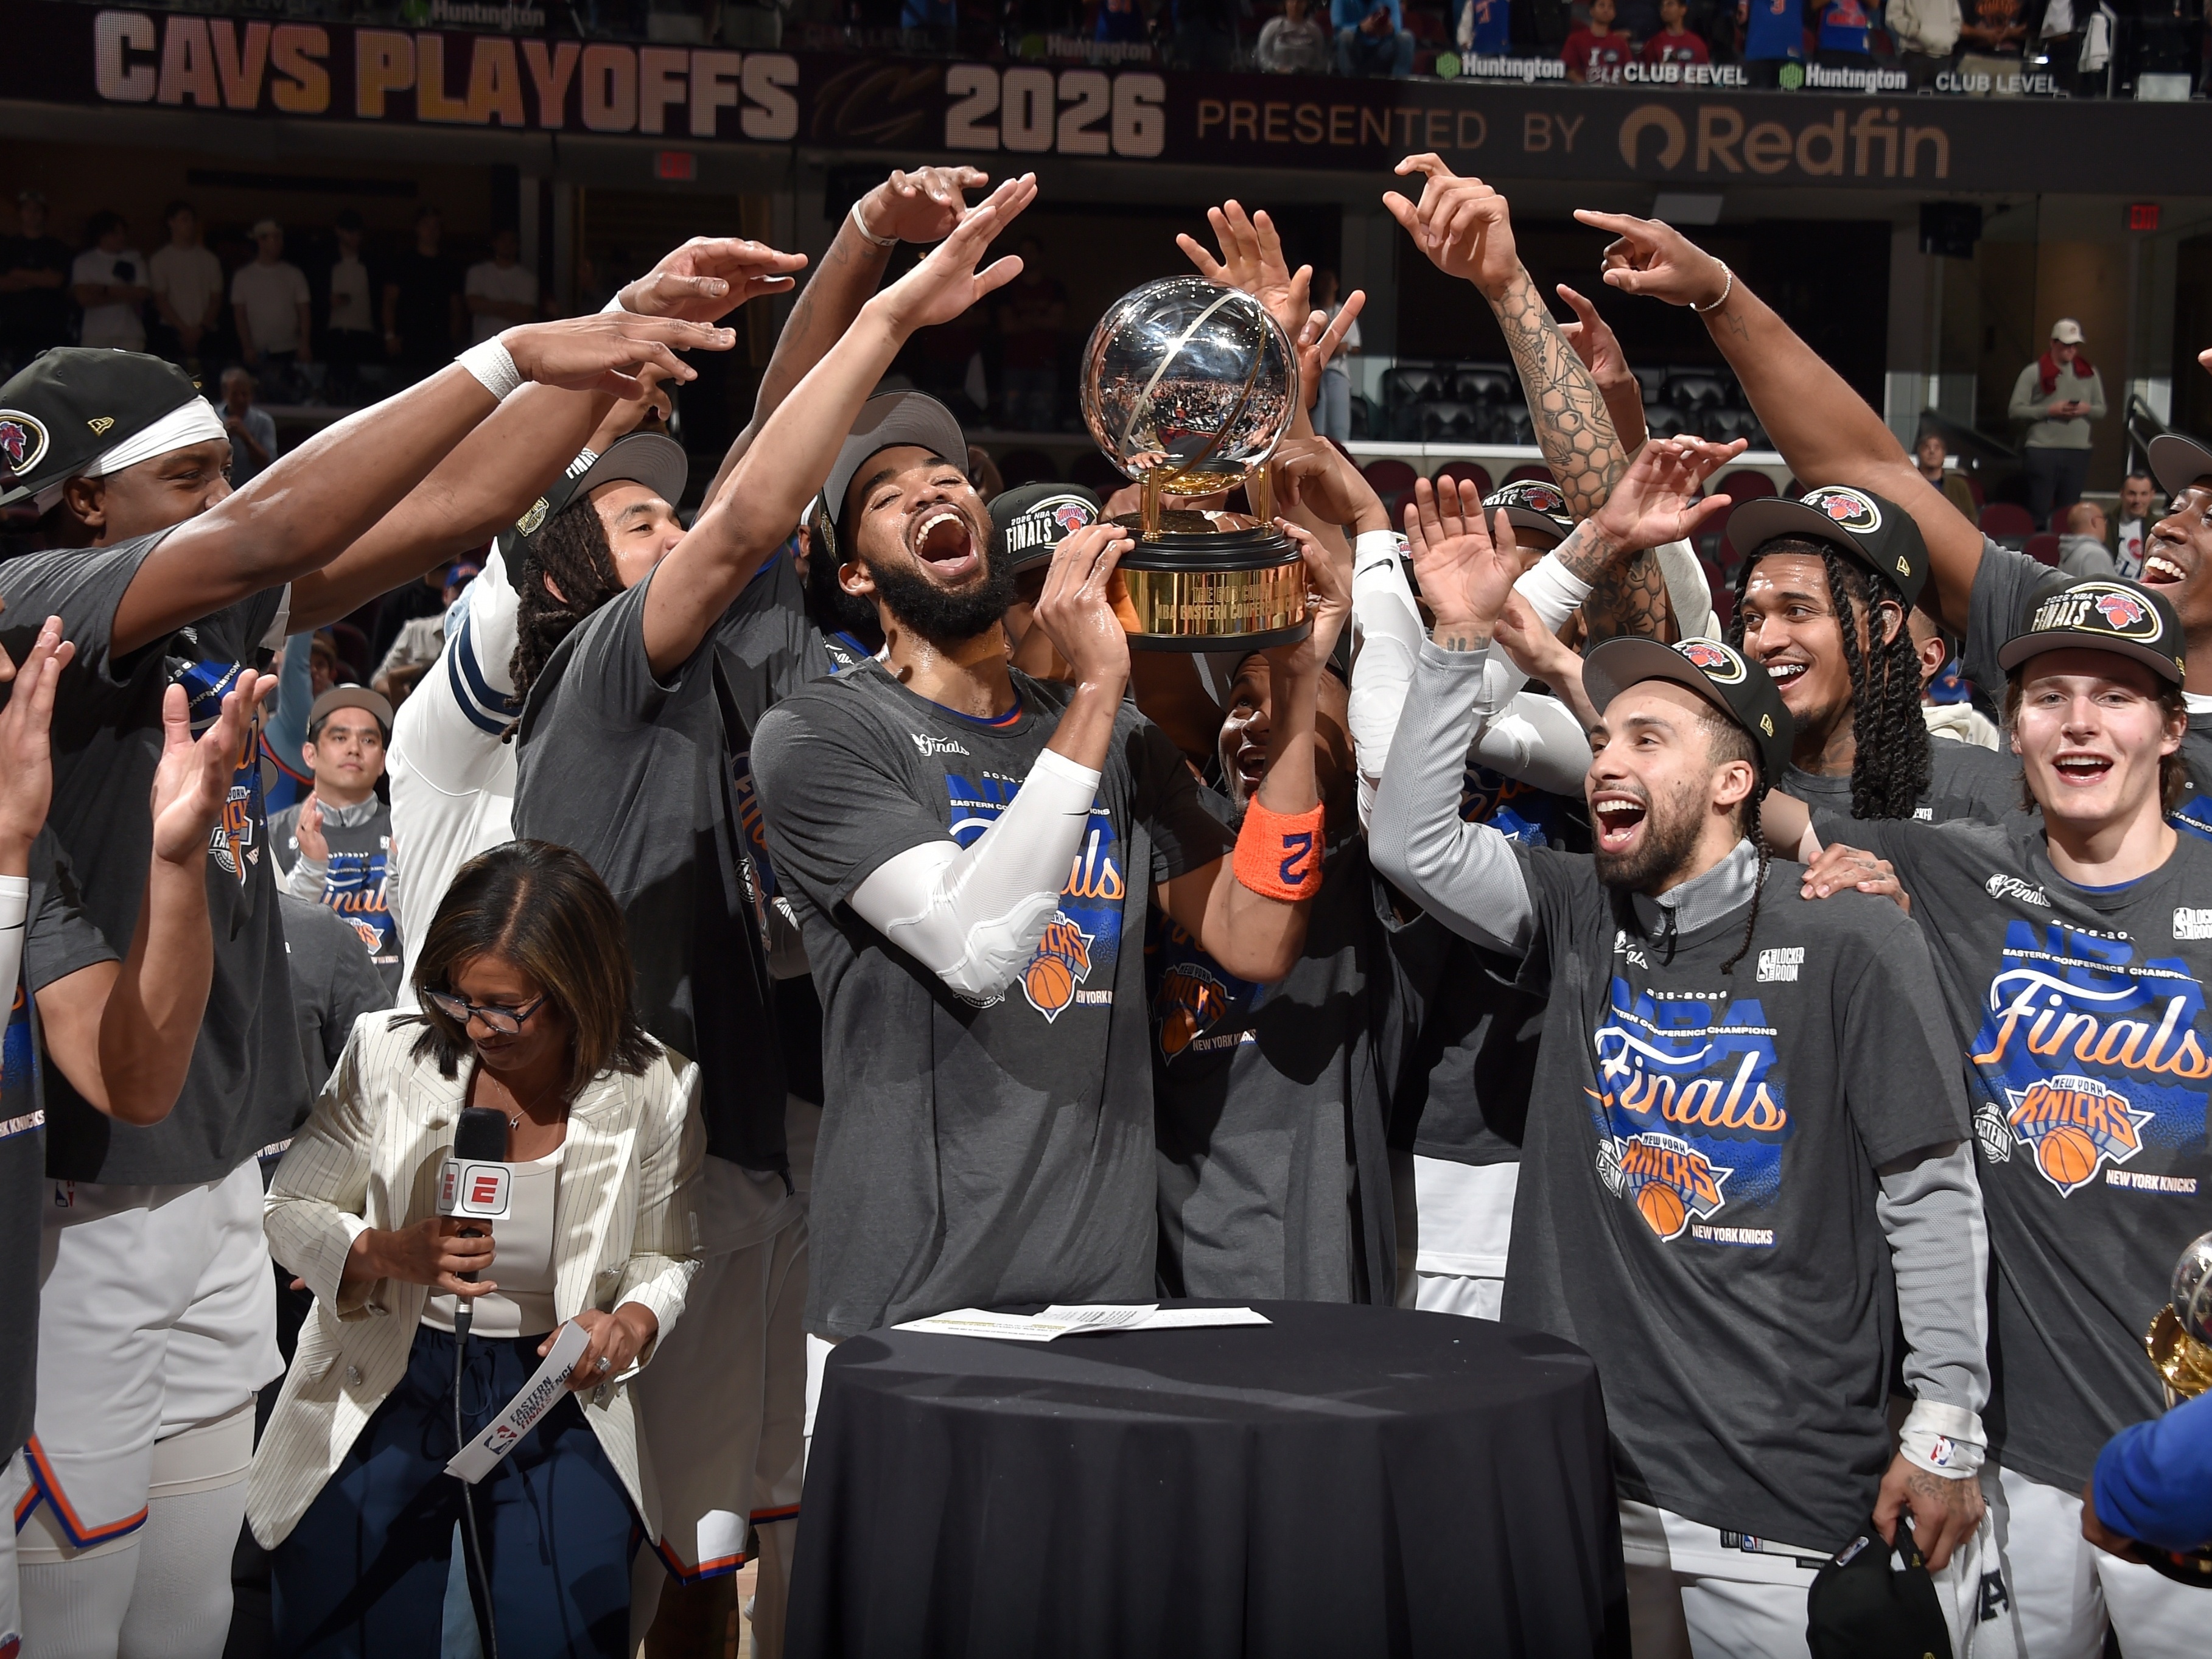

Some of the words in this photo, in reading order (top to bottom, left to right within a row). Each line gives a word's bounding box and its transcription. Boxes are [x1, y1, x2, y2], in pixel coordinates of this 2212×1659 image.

[94, 9, 331, 114] CAVS
[354, 29, 799, 141] PLAYOFFS
[1463, 53, 1566, 83] Huntington
[1623, 61, 1680, 83] CLUB
[1805, 63, 1908, 94] Huntington
[1936, 72, 1992, 92] CLUB
[1995, 74, 2060, 94] LEVEL
[945, 64, 1166, 157] 2026
[1197, 99, 1487, 150] PRESENTED
[1524, 111, 1584, 153] BY
[1696, 107, 1947, 178] Redfin
[1034, 510, 1051, 520] NBA
[1005, 517, 1052, 554] FINALS
[2071, 592, 2094, 601] NBA
[1180, 604, 1227, 620] EASTERN
[1230, 599, 1282, 620] CONFERE
[2030, 600, 2092, 632] FINALS
[982, 770, 1027, 784] 2025-
[950, 799, 995, 809] EASTERN
[324, 876, 388, 913] inal
[2192, 924, 2212, 939] ROO
[1777, 947, 1805, 965] LOCKER
[2003, 948, 2051, 961] EASTERN
[2051, 955, 2125, 974] CONFERENCE
[2129, 967, 2203, 984] CHAMPIO
[1775, 963, 1799, 982] ROOM
[1087, 991, 1107, 1004] YORK
[1639, 1019, 1706, 1038] CONFERENCE
[1706, 1025, 1778, 1036] CHAMPIONS
[1965, 968, 2212, 1080] Finals
[1192, 1039, 1211, 1052] NEW
[1212, 1035, 1233, 1049] YORK
[1583, 1025, 1788, 1131] Finals
[2053, 1077, 2075, 1090] NEW
[2077, 1080, 2104, 1096] YORK
[11, 1109, 46, 1134] KNICKS
[2009, 1087, 2138, 1149] KNICKS
[1643, 1134, 1661, 1146] NEW
[1662, 1137, 1687, 1154] YORK
[1619, 1138, 1721, 1206] KNICKS
[2105, 1169, 2130, 1186] NEW
[2130, 1173, 2159, 1192] YORK
[2160, 1176, 2197, 1193] KNICKS
[1691, 1224, 1712, 1238] NEW
[1713, 1227, 1738, 1242] YORK
[1738, 1229, 1773, 1245] KNICKS
[510, 1376, 552, 1423] EASTERN
[516, 1362, 574, 1427] CONFERENCE
[520, 1397, 553, 1430] FINALS
